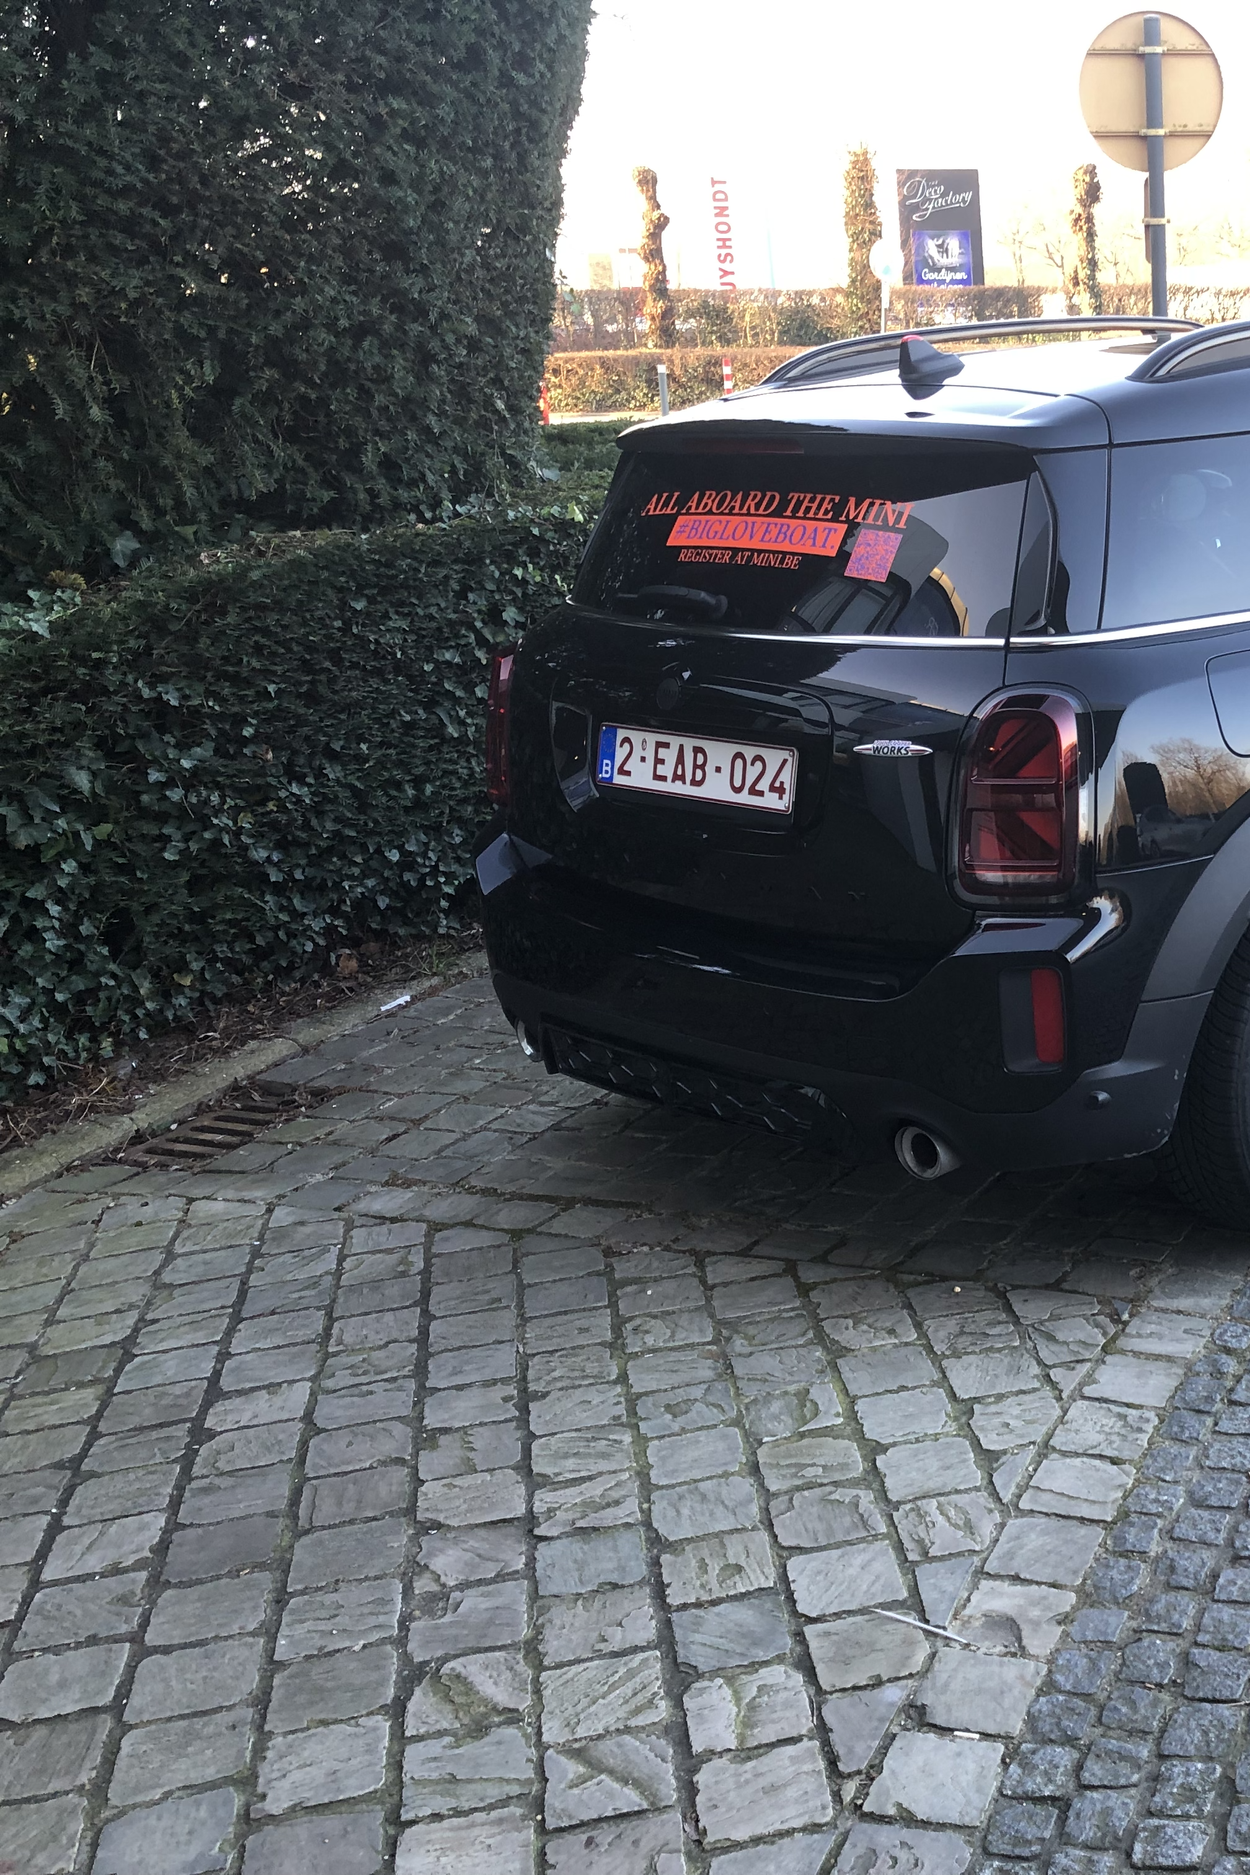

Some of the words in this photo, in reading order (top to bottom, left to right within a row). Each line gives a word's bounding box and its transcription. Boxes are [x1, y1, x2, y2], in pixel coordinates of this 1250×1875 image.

[904, 177, 944, 205] Deco
[912, 190, 973, 221] Factory
[921, 268, 968, 283] Gordijnen
[641, 491, 681, 516] ALL
[681, 490, 780, 515] ABOARD
[783, 492, 840, 519] THE
[839, 497, 915, 529] MINI
[674, 519, 838, 550] #BIGLOVEBOAT.
[678, 549, 733, 565] REGISTER
[733, 551, 753, 565] AT
[750, 552, 802, 570] MINI.BE
[872, 746, 911, 756] WORKS
[602, 760, 612, 777] B
